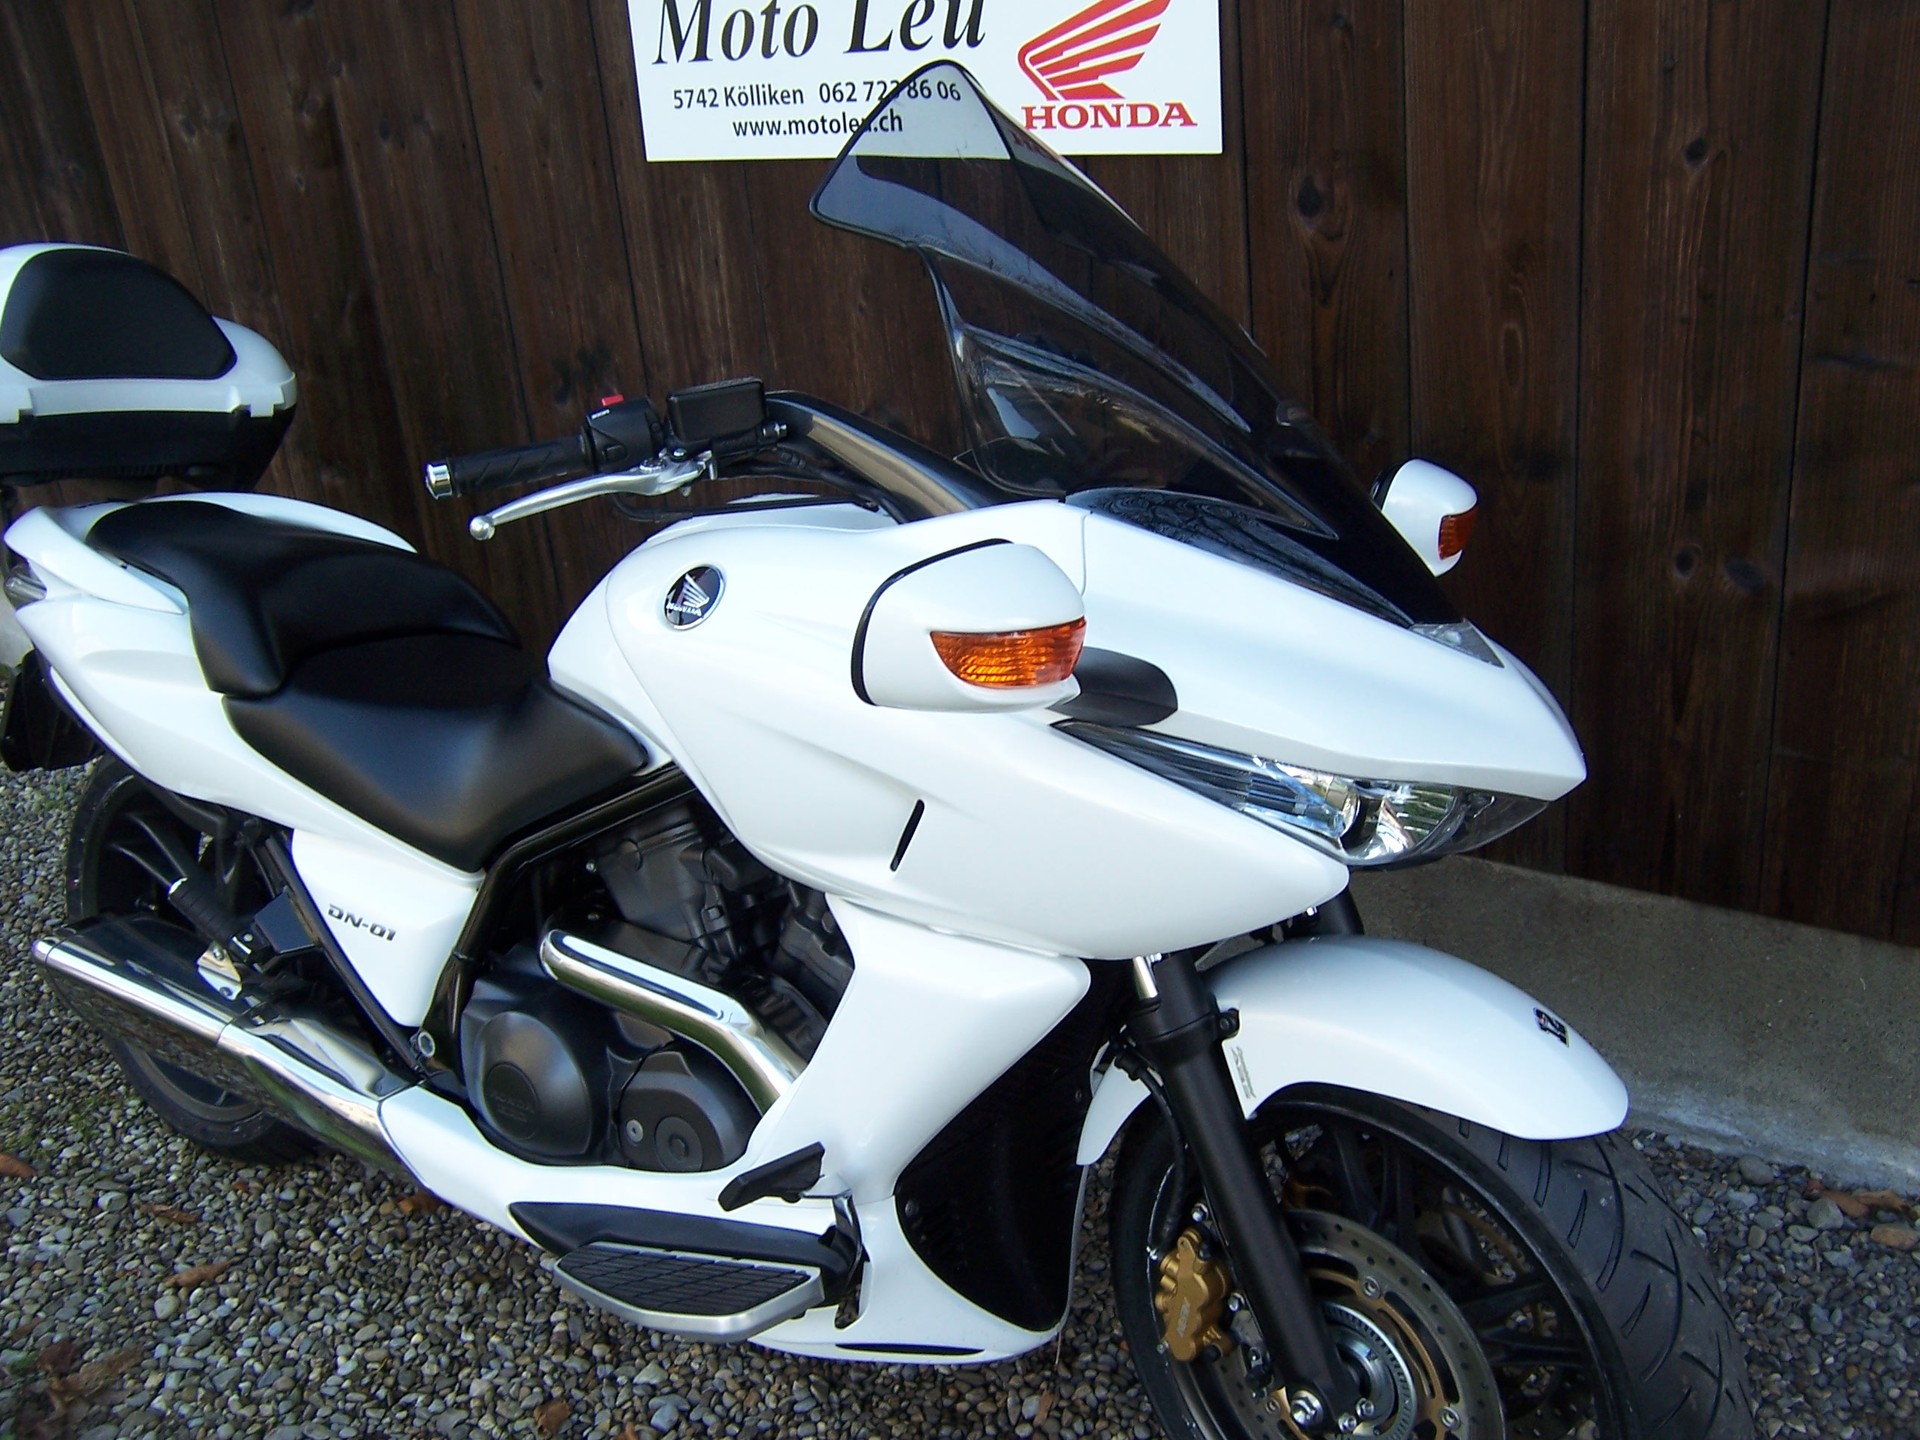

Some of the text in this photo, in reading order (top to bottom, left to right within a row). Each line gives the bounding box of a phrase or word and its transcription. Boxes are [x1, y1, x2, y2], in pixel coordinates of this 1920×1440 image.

[652, 0, 985, 64] Moto Leu
[673, 88, 719, 109] 5742
[723, 83, 804, 107] Kölliken
[819, 81, 857, 103] 062
[907, 79, 932, 99] 86
[937, 80, 961, 101] 06
[1021, 102, 1198, 130] HONDA
[328, 904, 396, 942] DN-01
